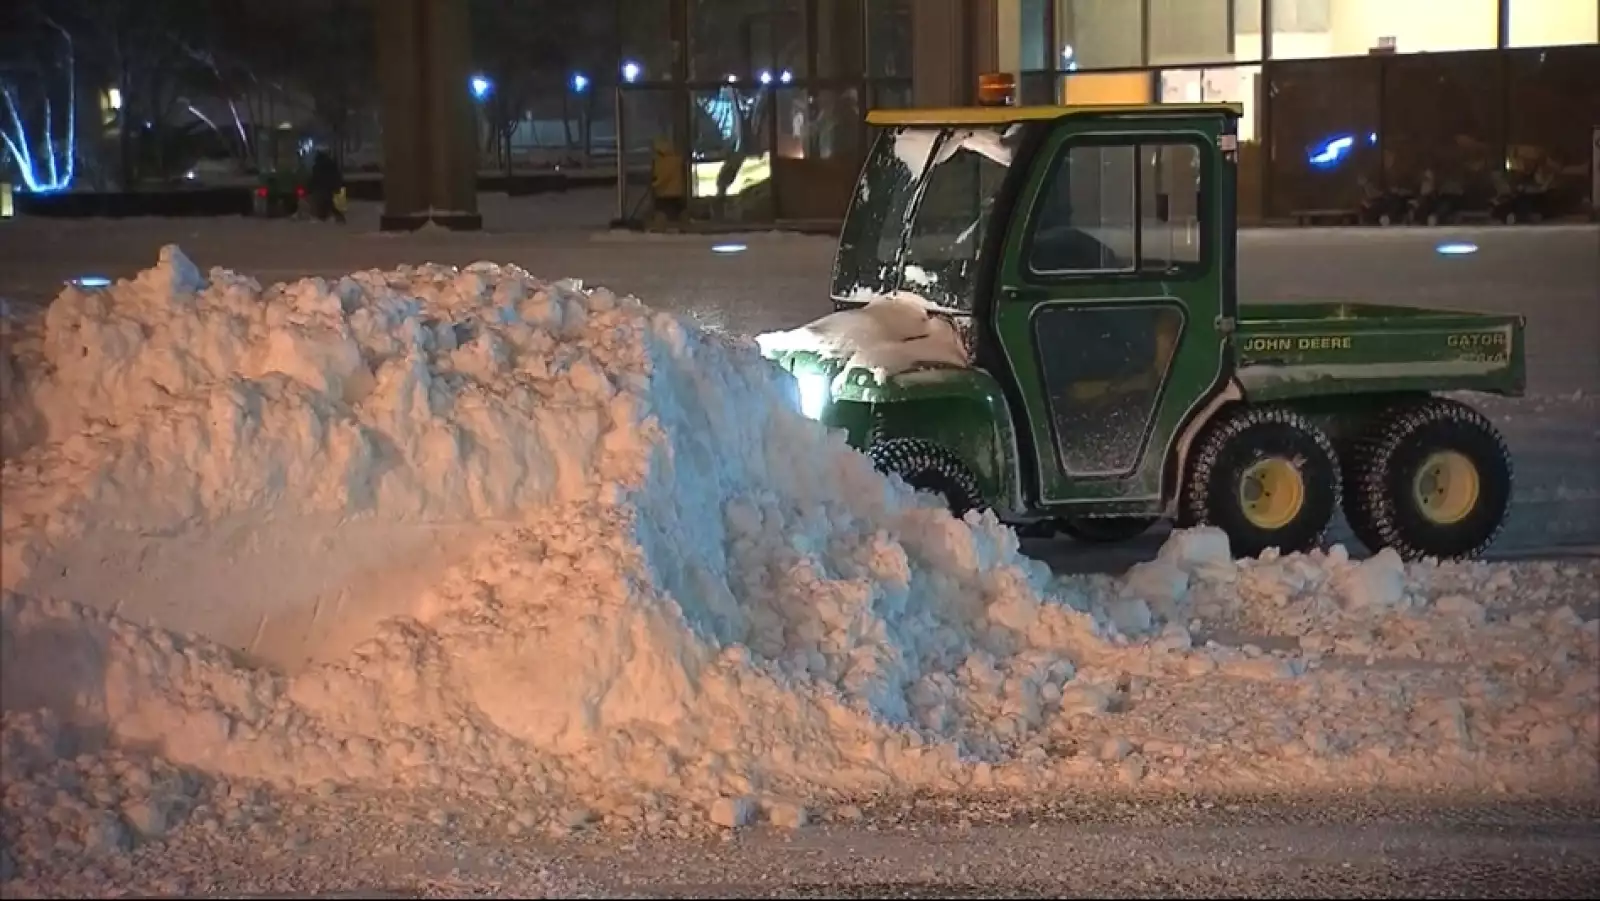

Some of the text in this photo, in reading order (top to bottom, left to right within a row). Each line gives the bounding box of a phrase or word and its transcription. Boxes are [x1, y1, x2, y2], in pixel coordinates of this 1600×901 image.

[1243, 337, 1351, 351] JOHN DEERE
[1447, 334, 1504, 346] GATOR
